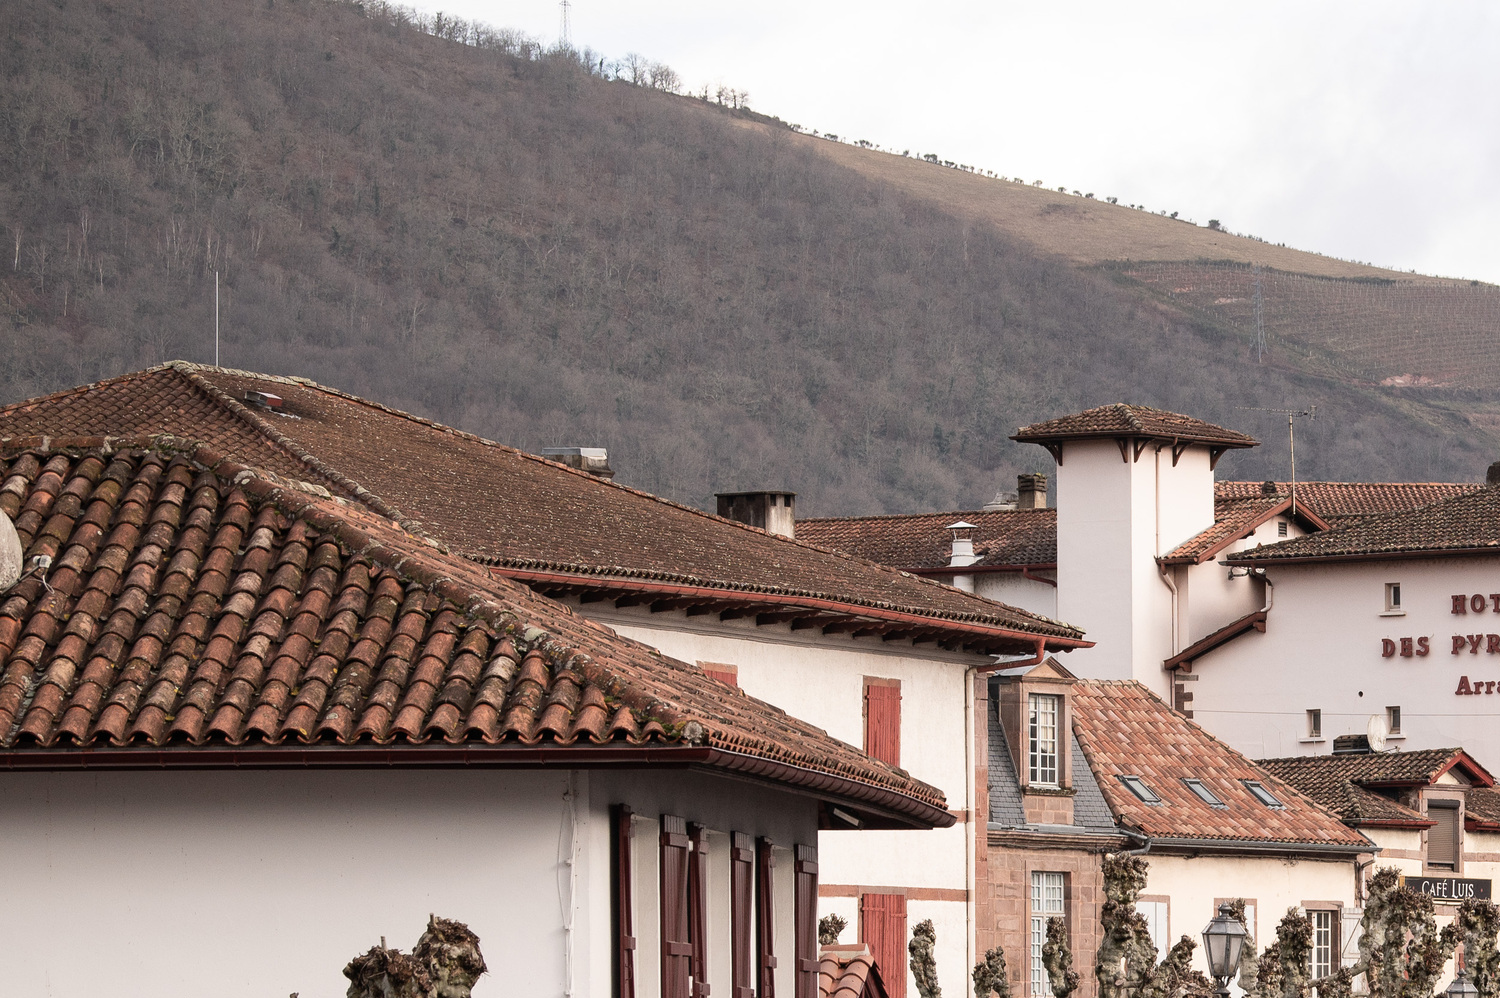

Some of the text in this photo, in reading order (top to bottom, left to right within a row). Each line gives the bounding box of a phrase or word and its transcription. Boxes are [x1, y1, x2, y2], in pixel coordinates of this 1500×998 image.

[1382, 636, 1430, 658] DES
[1421, 879, 1475, 899] CAFÉ LUIS
